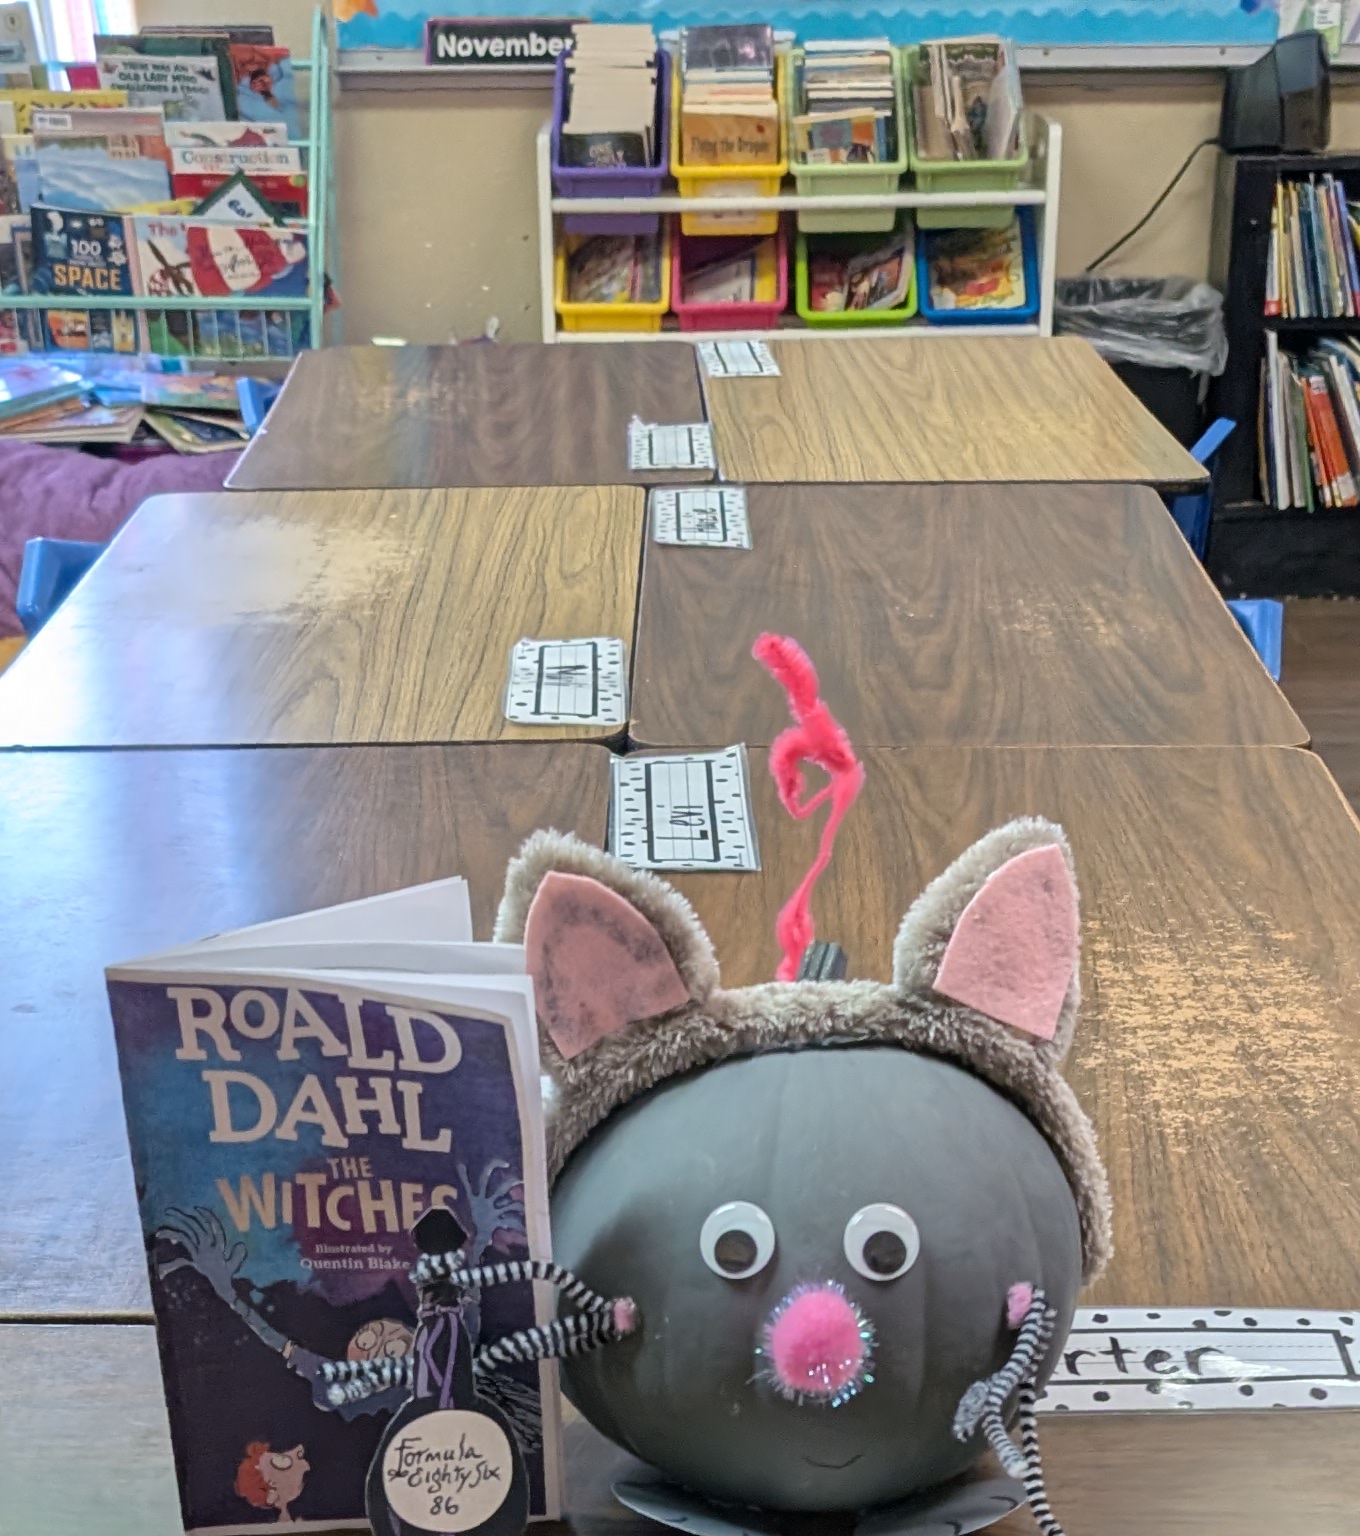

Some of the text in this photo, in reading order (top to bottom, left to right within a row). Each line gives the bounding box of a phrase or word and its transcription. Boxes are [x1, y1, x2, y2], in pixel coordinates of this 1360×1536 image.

[436, 33, 574, 58] November
[181, 150, 290, 165] Construction
[70, 239, 102, 256] 100
[54, 263, 122, 291] SPACE
[166, 985, 463, 1075] ROALD
[202, 1069, 453, 1154] DAHL
[326, 1156, 374, 1180] THE
[315, 1243, 393, 1255] Illustrated by
[300, 1257, 412, 1270] Quentin Blake
[394, 1433, 482, 1471] Formula
[429, 1495, 460, 1516] 86
